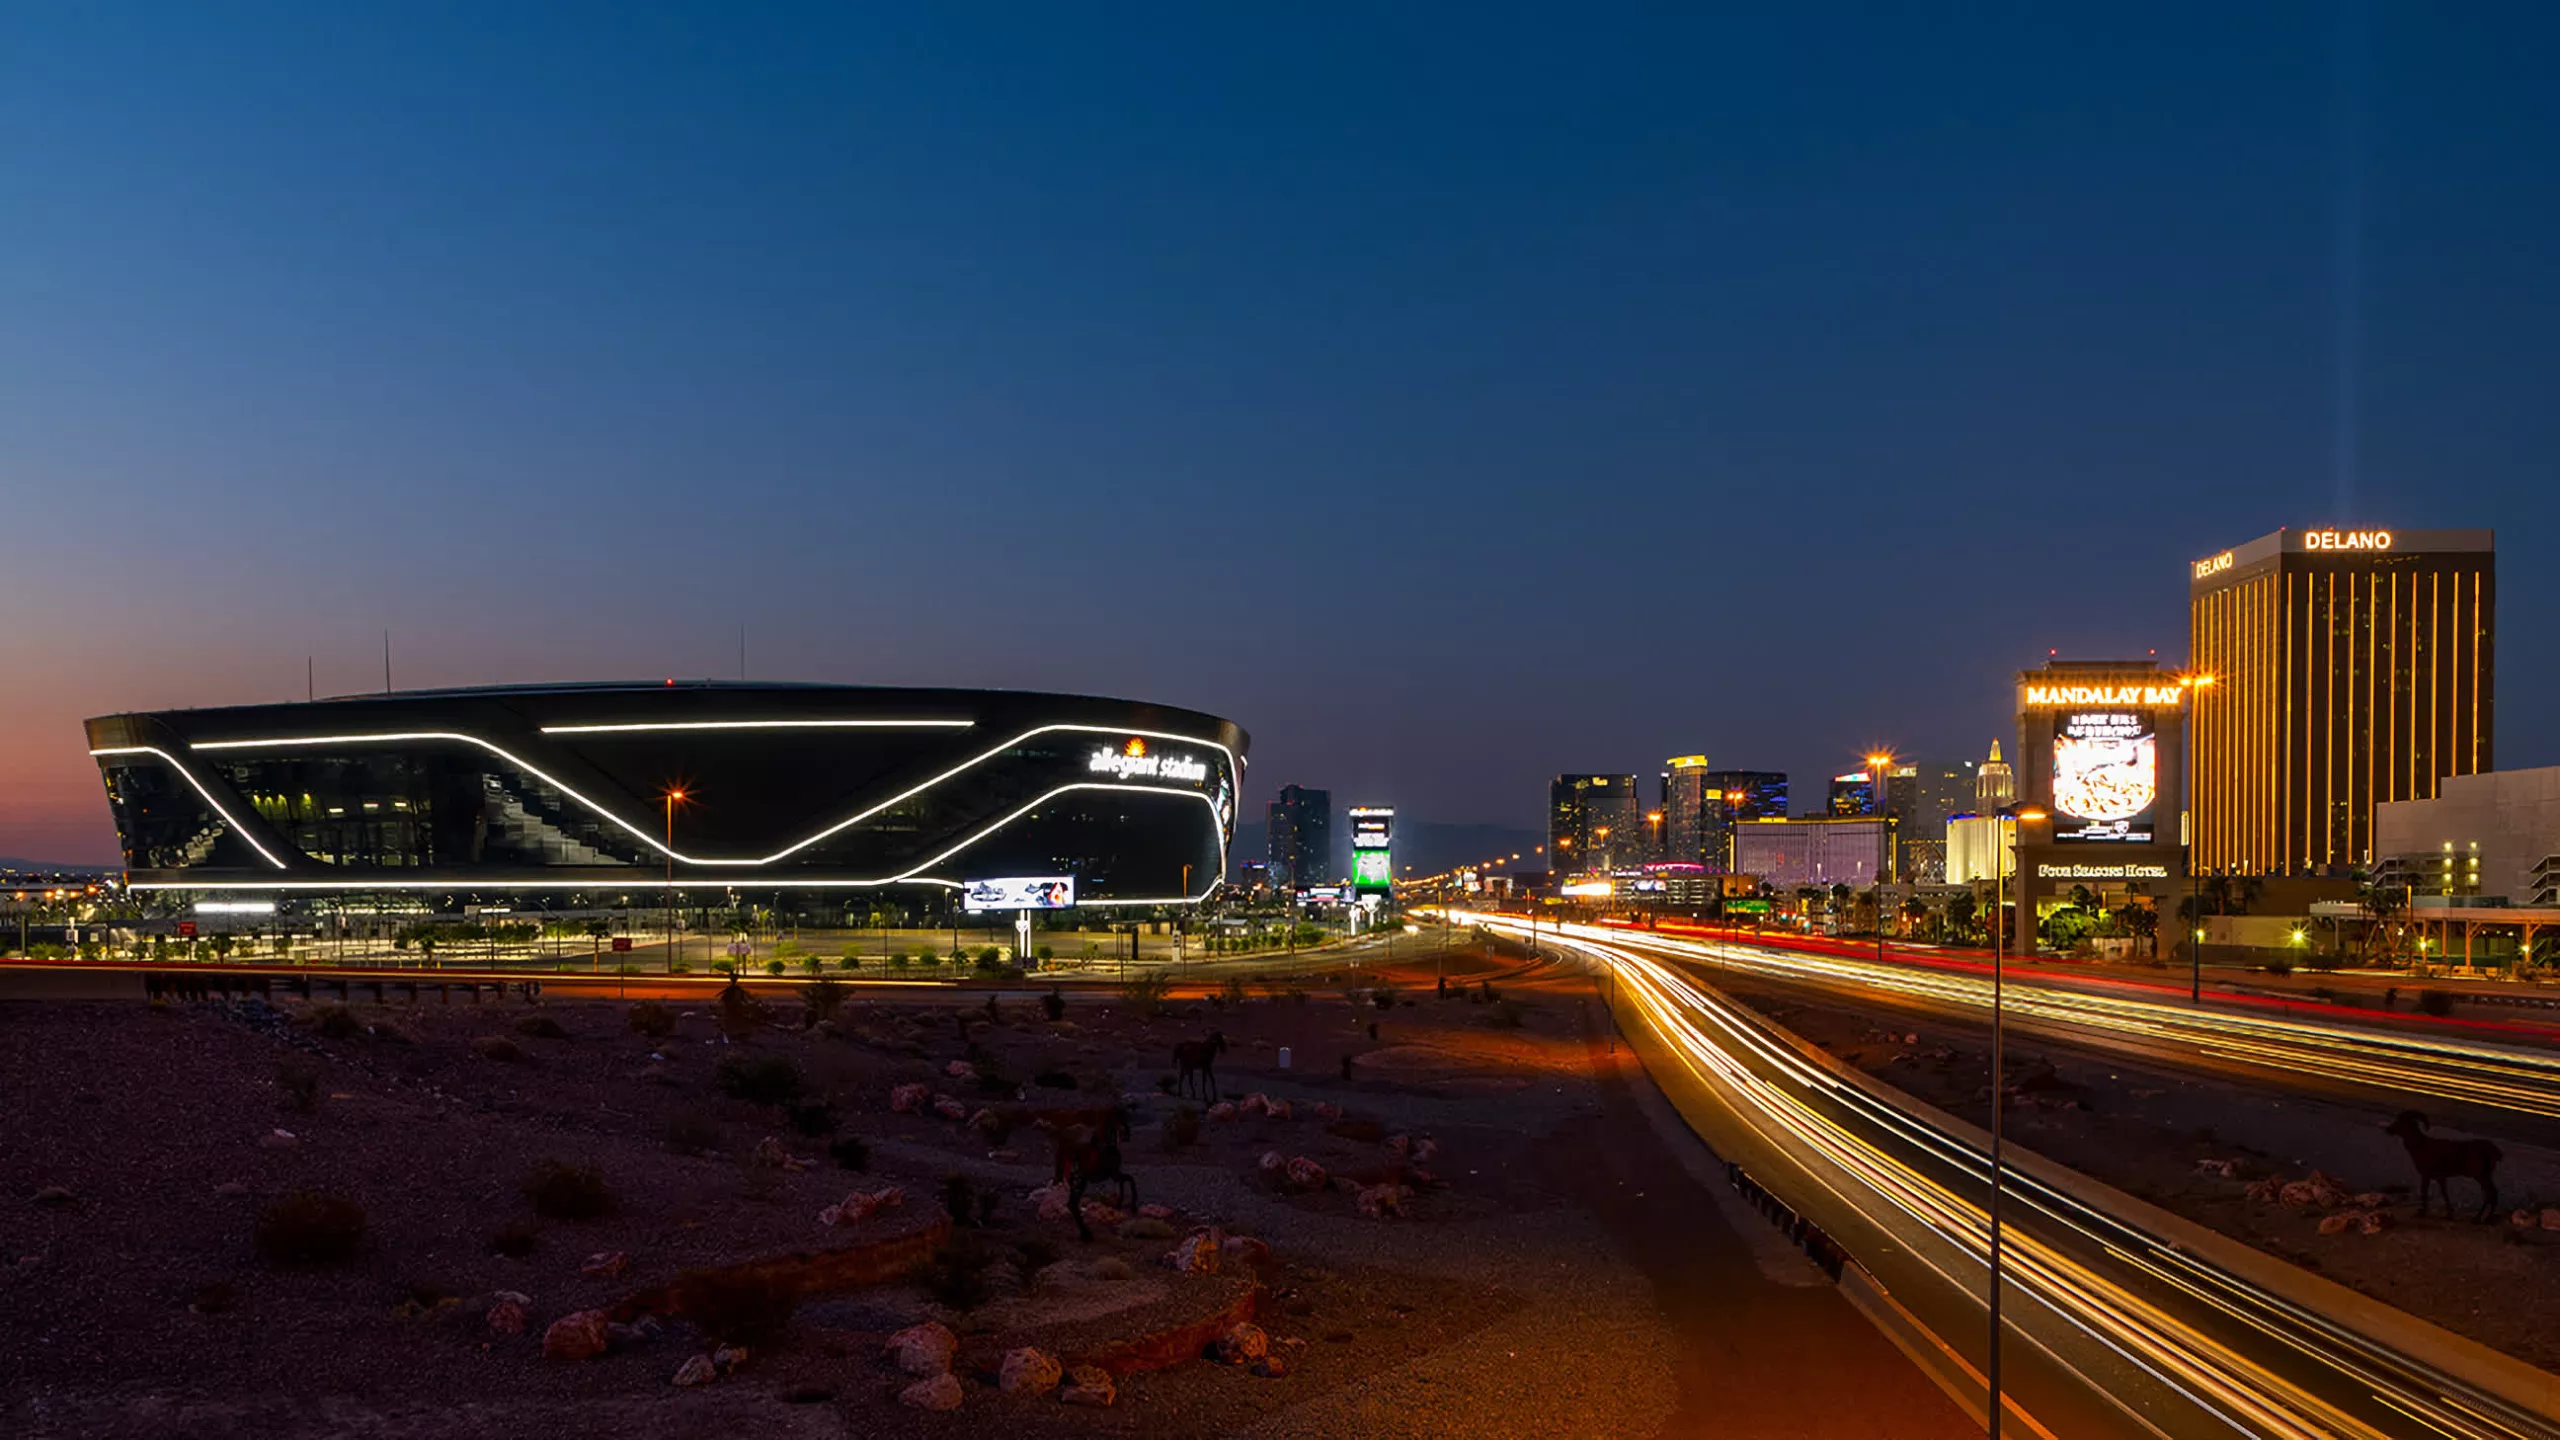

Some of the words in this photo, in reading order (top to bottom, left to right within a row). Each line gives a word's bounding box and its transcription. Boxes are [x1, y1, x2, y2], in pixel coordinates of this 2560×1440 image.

[2305, 531, 2392, 550] DELANO
[2196, 552, 2234, 579] DELANO
[2027, 687, 2141, 704] MANDALAY
[2144, 687, 2183, 704] BAY
[1090, 747, 1159, 780] allegiant
